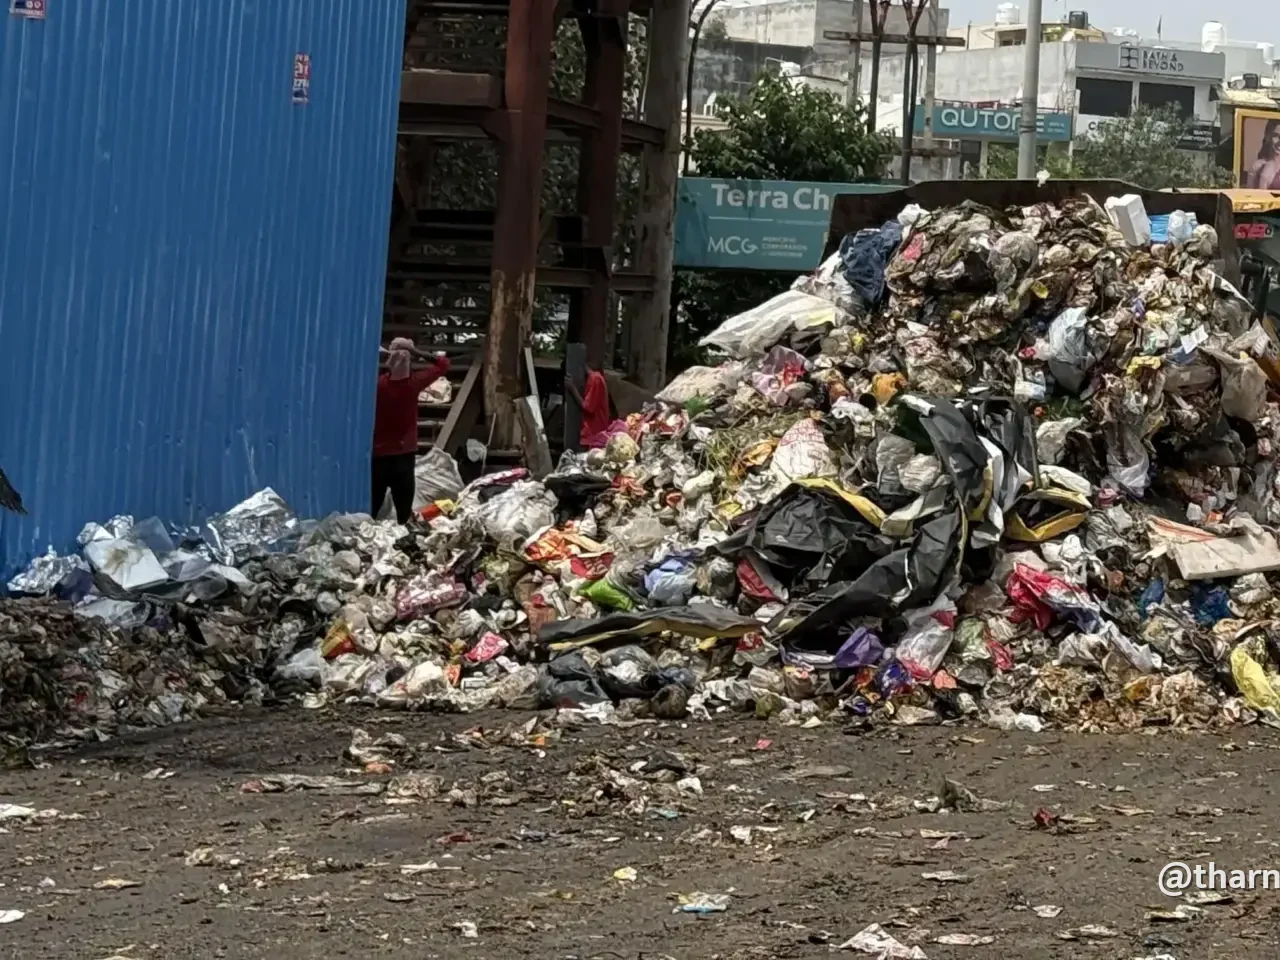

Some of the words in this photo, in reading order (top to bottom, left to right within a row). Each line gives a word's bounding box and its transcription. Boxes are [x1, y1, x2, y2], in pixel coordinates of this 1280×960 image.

[1143, 61, 1184, 72] BEYOND
[940, 109, 1045, 133] QUTOE
[711, 183, 789, 209] Terra
